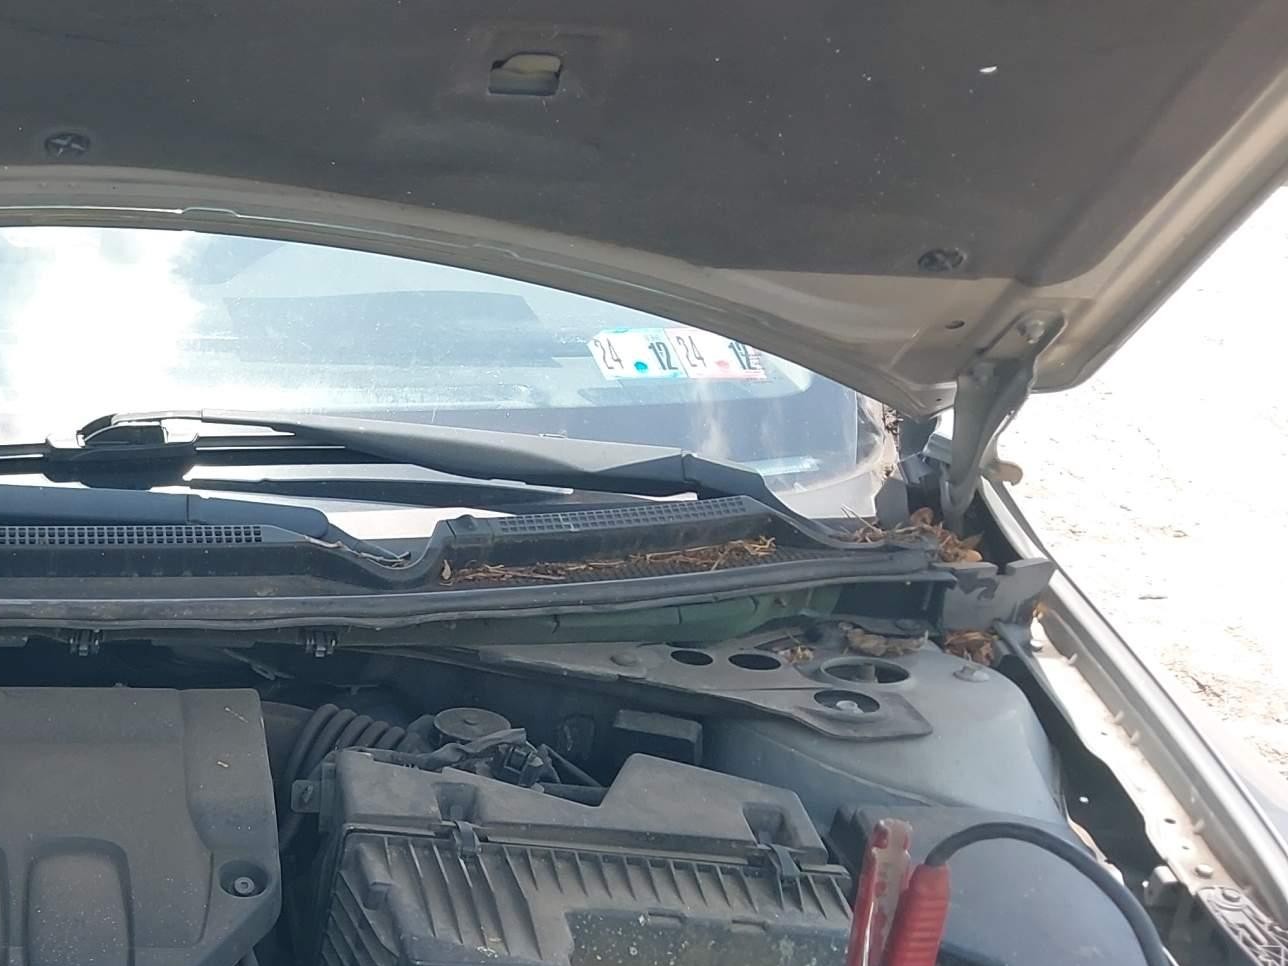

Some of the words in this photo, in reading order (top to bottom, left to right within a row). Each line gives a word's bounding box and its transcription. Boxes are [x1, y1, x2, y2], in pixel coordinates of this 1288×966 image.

[593, 337, 625, 370] 24
[648, 341, 680, 371] 12
[676, 335, 708, 368] 24
